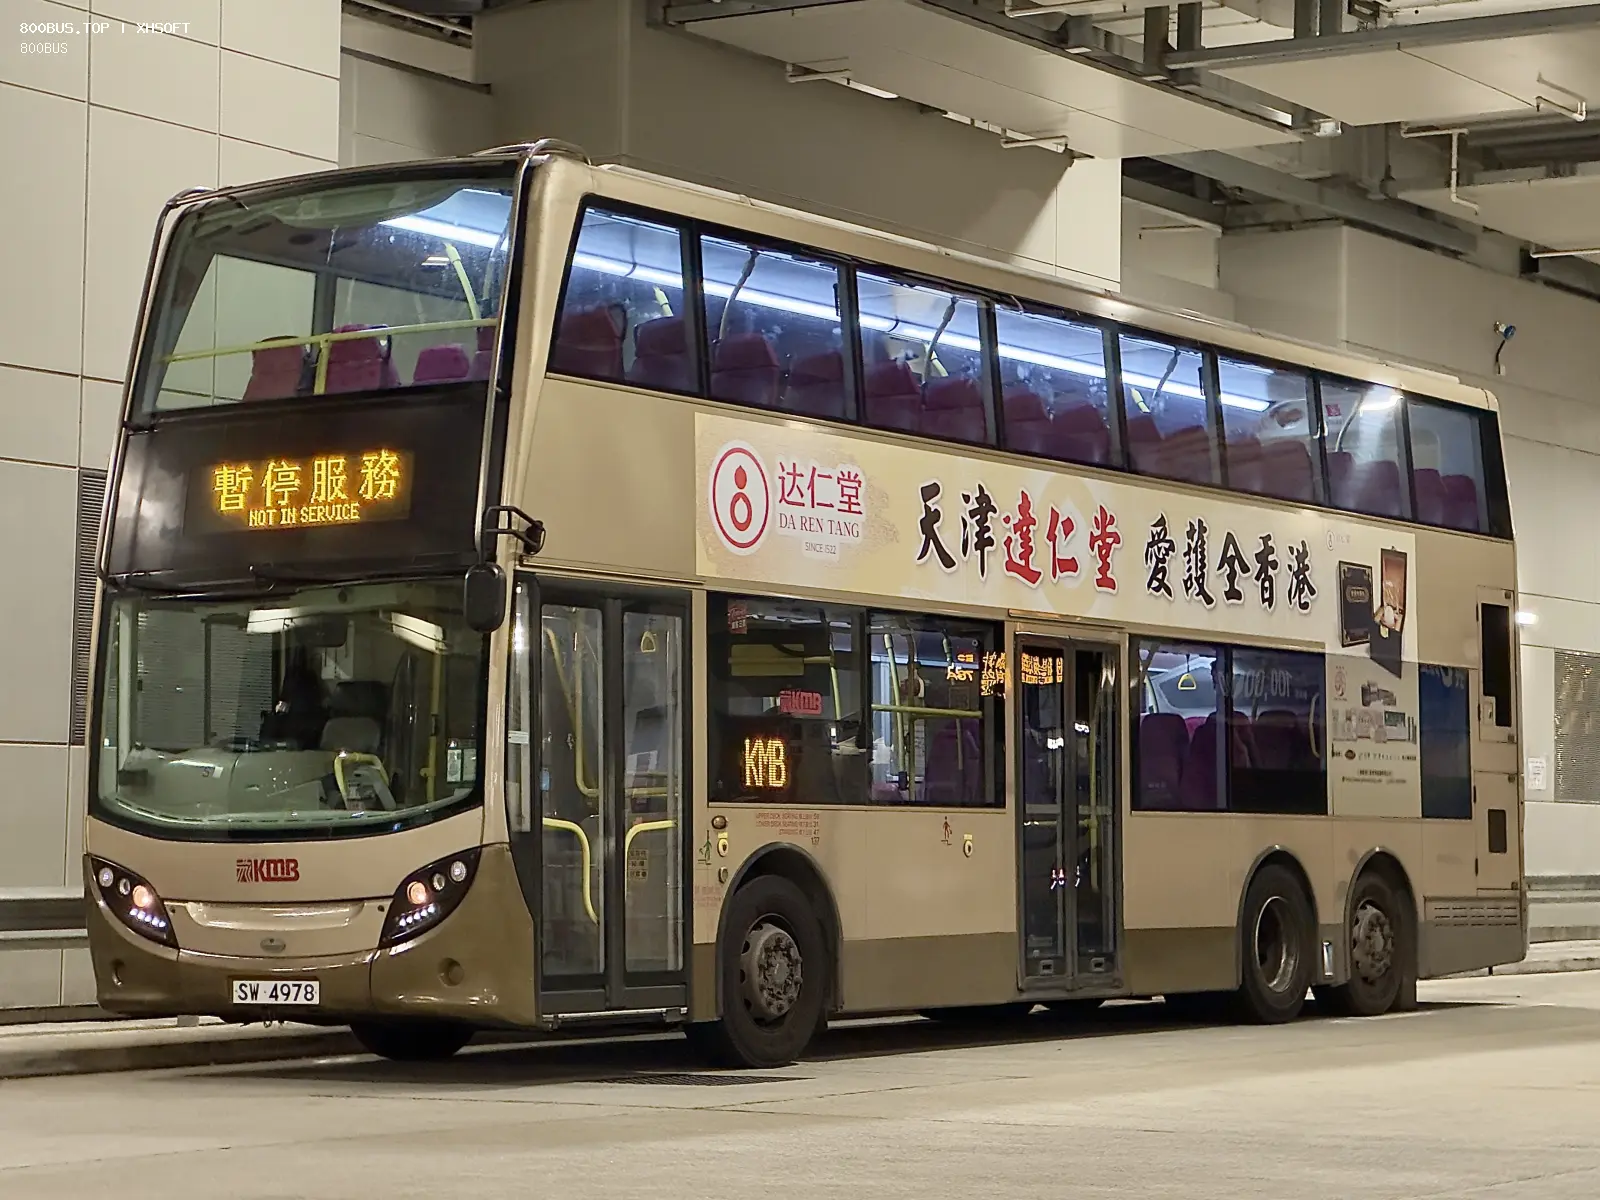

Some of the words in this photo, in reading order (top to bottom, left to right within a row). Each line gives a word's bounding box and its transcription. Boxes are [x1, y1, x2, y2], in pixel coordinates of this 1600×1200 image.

[214, 449, 400, 511] 暫停服務
[778, 461, 863, 515] 达仁堂
[249, 508, 277, 527] NOT
[280, 508, 296, 525] IN
[300, 502, 361, 523] SERVICE
[779, 512, 796, 530] DA
[800, 515, 824, 533] REN
[827, 519, 860, 538] TANG
[916, 482, 1121, 590] 天津達仁堂
[1145, 513, 1317, 611] 愛護全香港
[745, 738, 786, 787] KMB
[254, 859, 300, 883] KMB
[237, 983, 260, 1002] SW
[268, 983, 315, 1002] 4978
